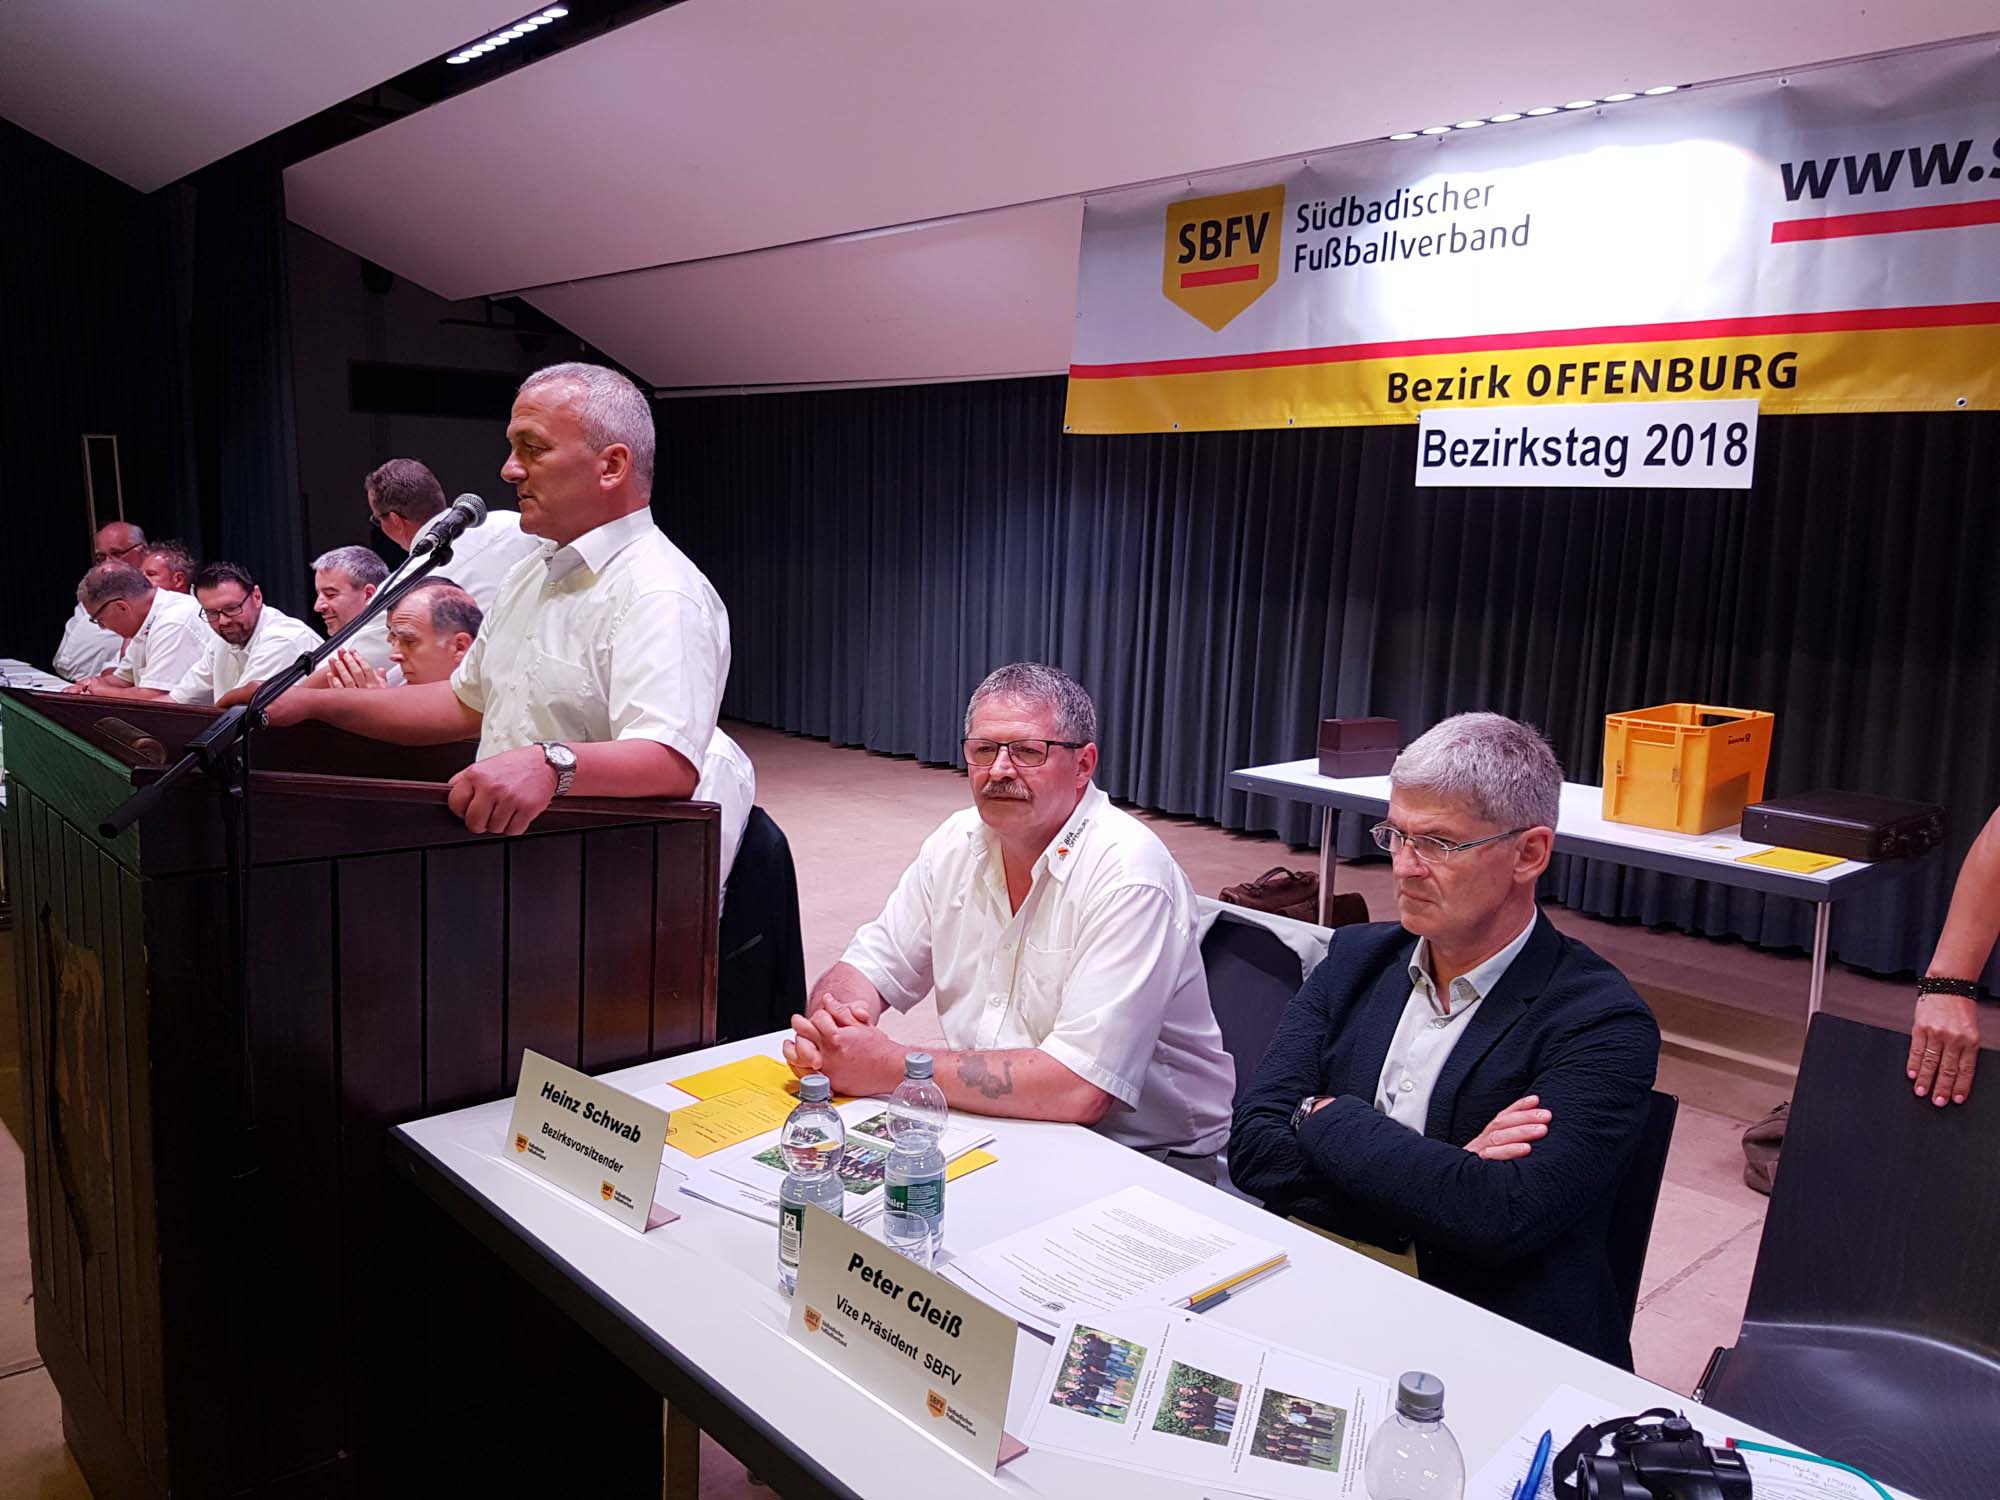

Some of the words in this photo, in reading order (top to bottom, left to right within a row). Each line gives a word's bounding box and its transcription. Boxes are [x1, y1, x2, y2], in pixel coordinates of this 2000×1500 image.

[1296, 181, 1495, 234] Südbadischer
[1178, 211, 1270, 264] SBFV
[1294, 213, 1531, 273] Fußballverband
[1387, 364, 1512, 404] Bezirk
[1527, 351, 1799, 398] OFFENBURG
[1422, 426, 1629, 478] Bezirkstag
[1643, 422, 1749, 467] 2018
[540, 1081, 582, 1114] Heinz
[582, 1102, 642, 1143] Schwab
[541, 1122, 624, 1174] Bezirksvorsitzender
[848, 1252, 904, 1300] Peter
[906, 1290, 963, 1338] Cleiß
[836, 1294, 859, 1321] Vize
[861, 1312, 919, 1360] Präsident
[923, 1353, 962, 1386] SBFV
